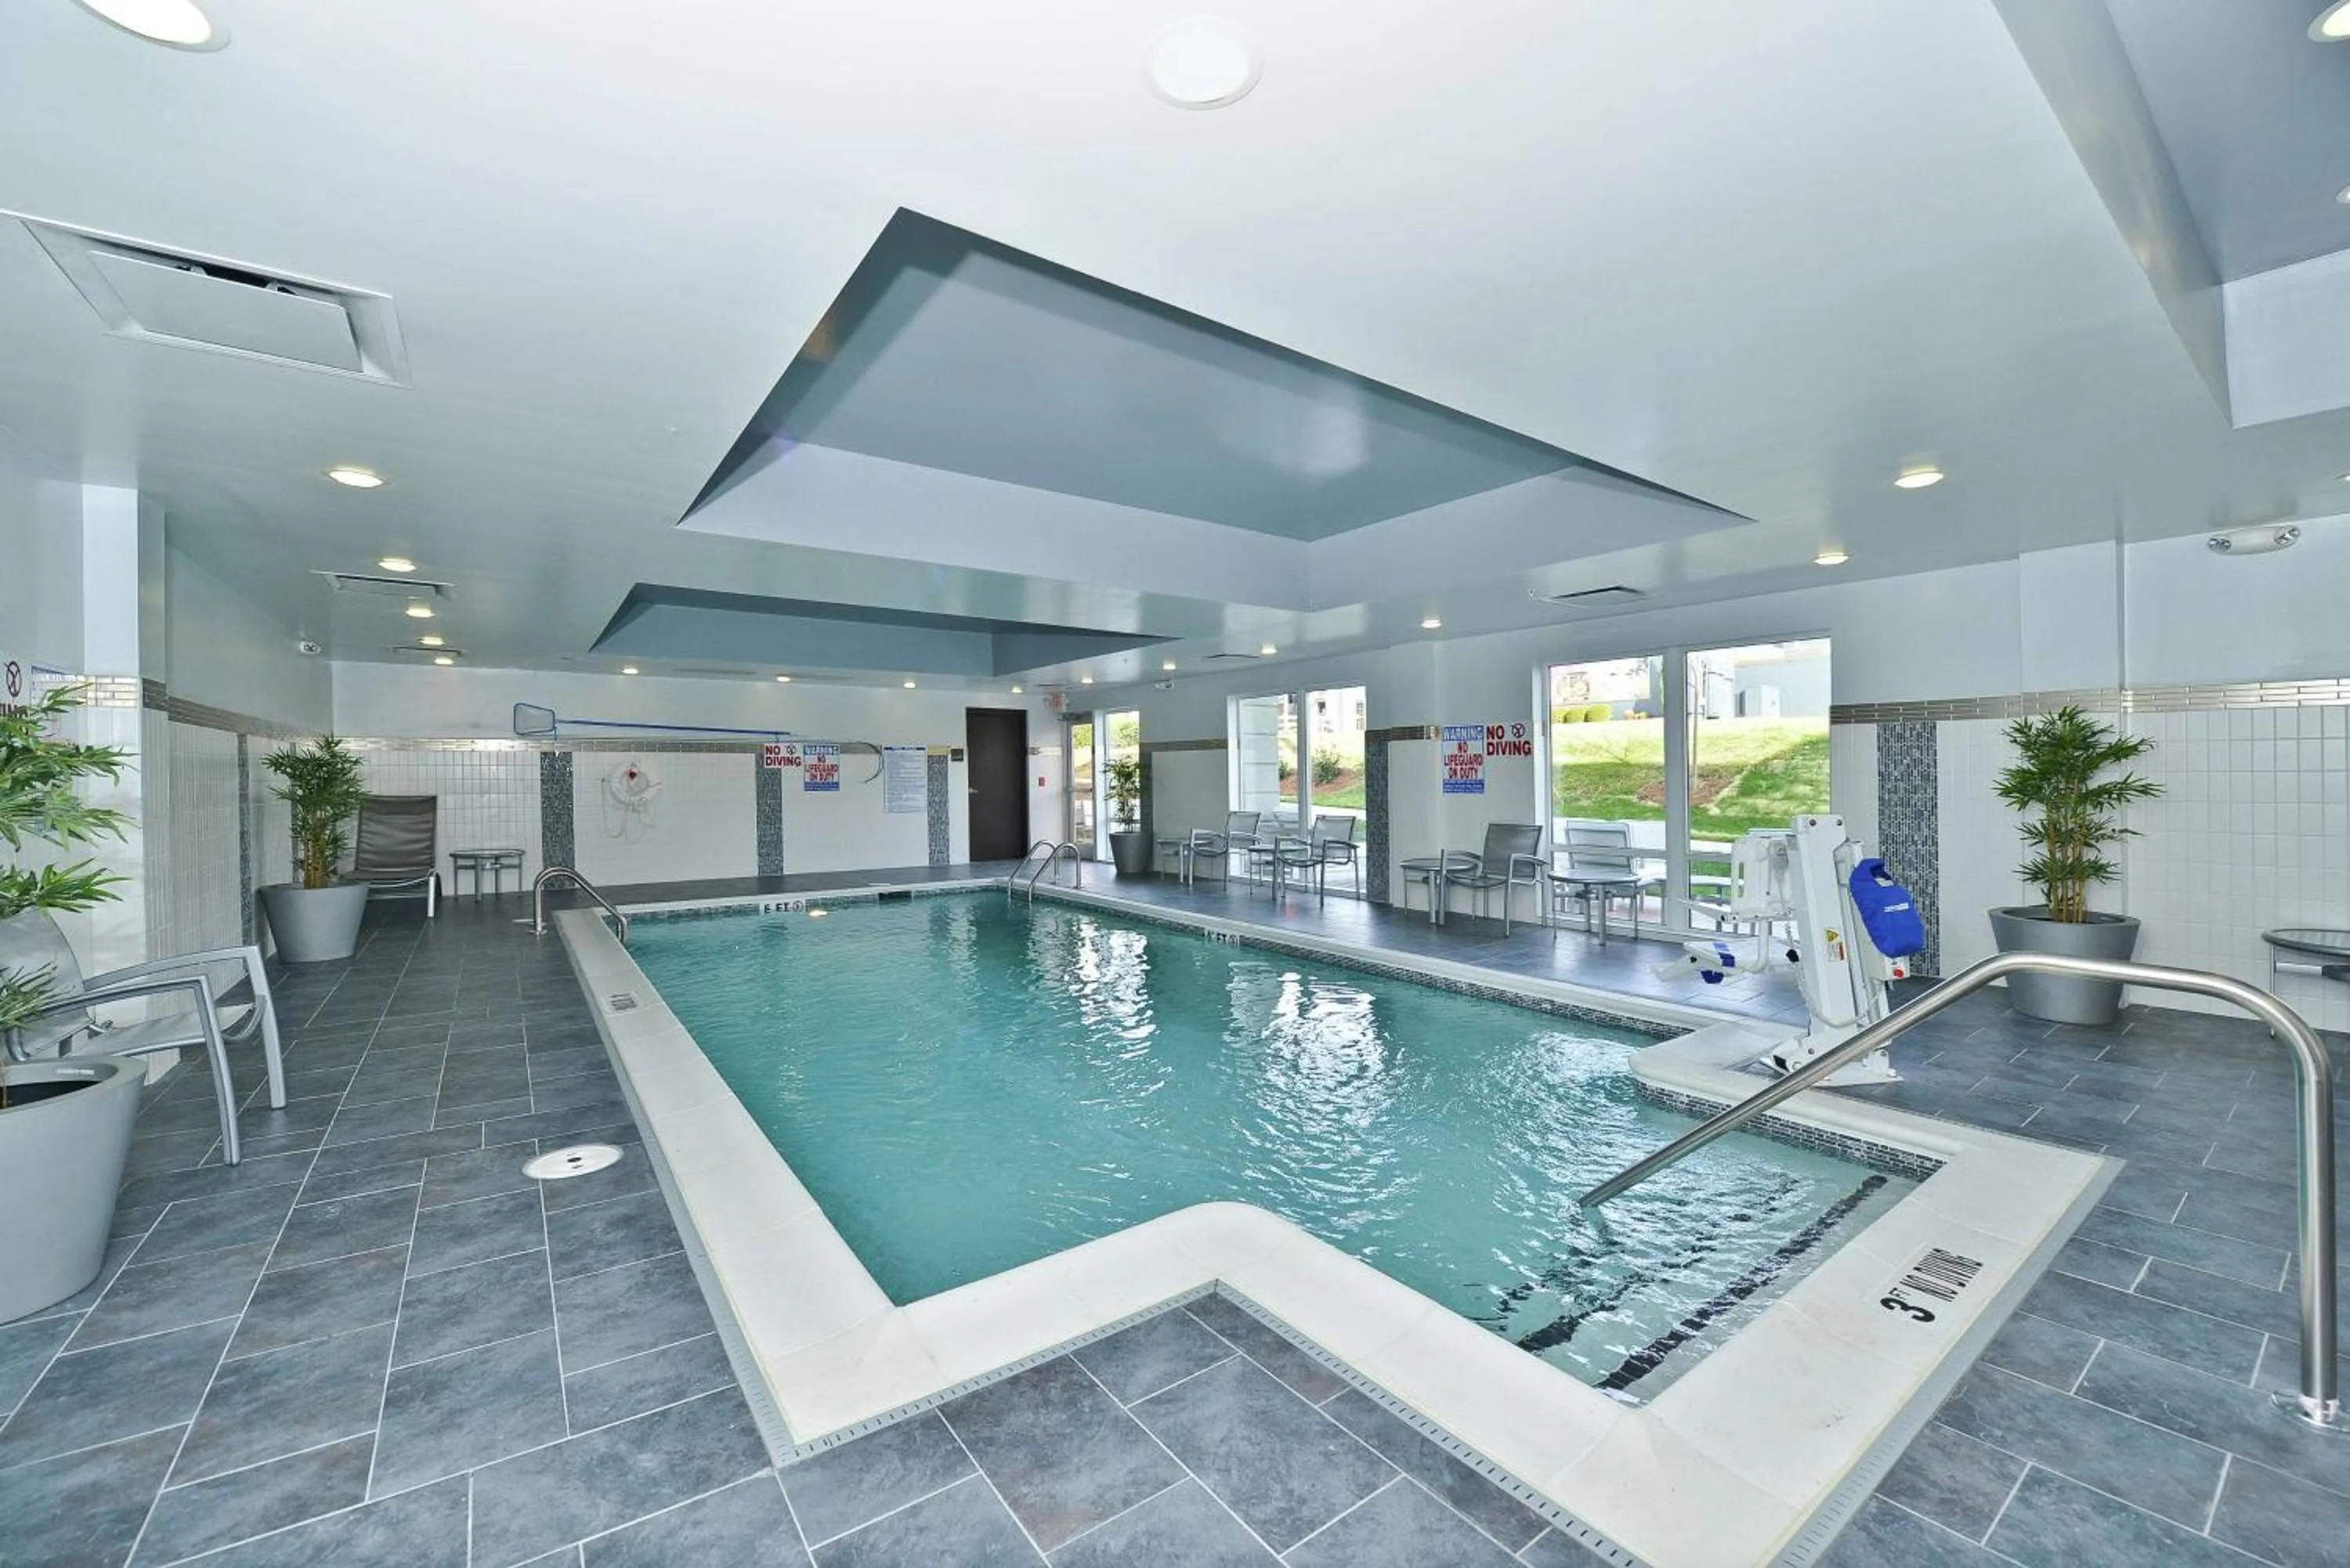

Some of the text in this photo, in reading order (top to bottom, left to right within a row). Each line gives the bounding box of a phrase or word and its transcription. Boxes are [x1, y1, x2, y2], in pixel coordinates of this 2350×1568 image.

[1486, 724, 1505, 740] NO
[765, 745, 781, 756] NO
[1458, 742, 1468, 753] NO
[1486, 741, 1532, 757] DIVING
[765, 756, 801, 767] DIVING
[1444, 754, 1483, 766] LIFEGUARD
[1460, 767, 1478, 779] DUTY
[1912, 1248, 1984, 1288] DIVING
[1899, 1274, 1959, 1302] NO
[1879, 1296, 1936, 1323] 3
